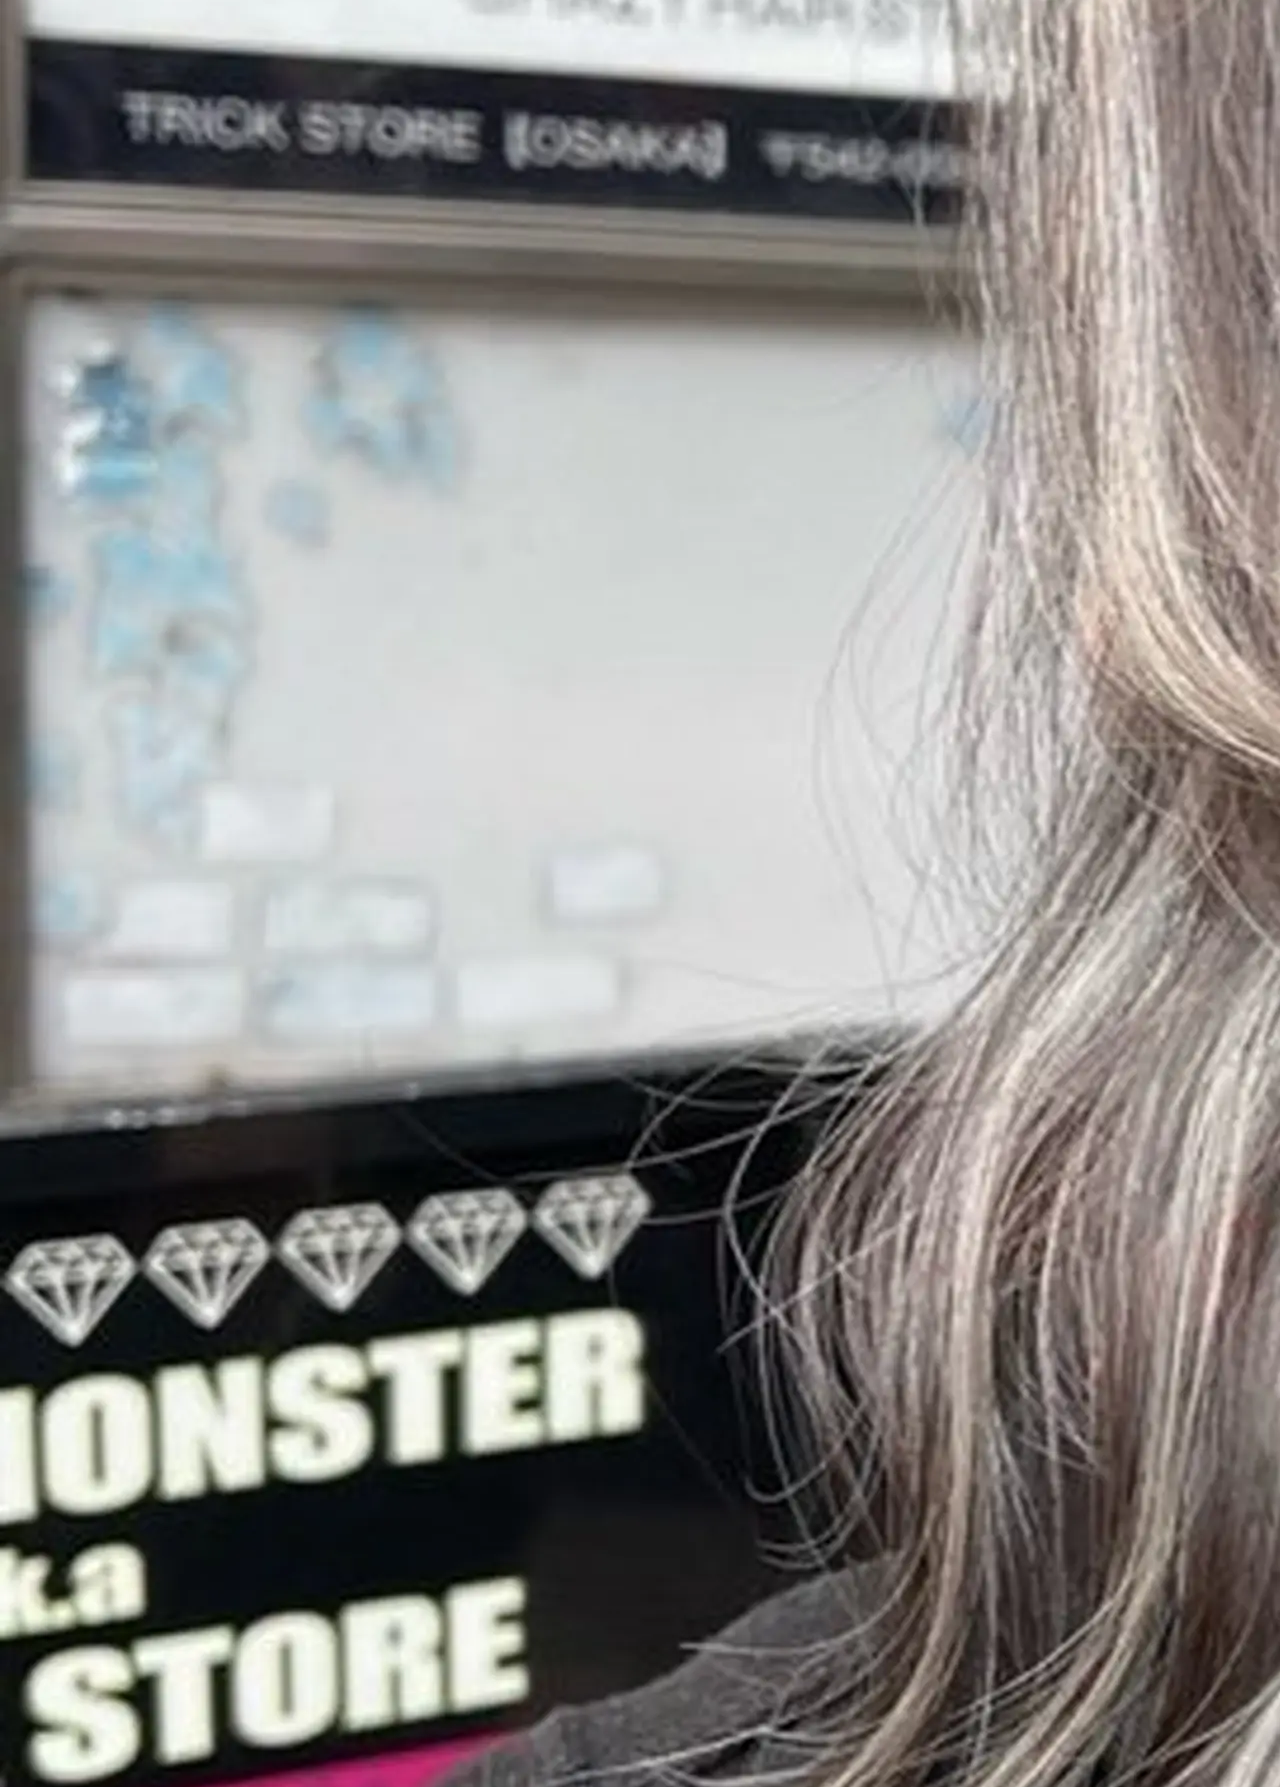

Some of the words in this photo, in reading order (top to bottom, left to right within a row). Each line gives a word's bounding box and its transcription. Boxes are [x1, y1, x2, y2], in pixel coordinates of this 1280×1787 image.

[121, 88, 290, 154] TRICK
[300, 98, 482, 164] STORE
[23, 1575, 531, 1787] STORE
